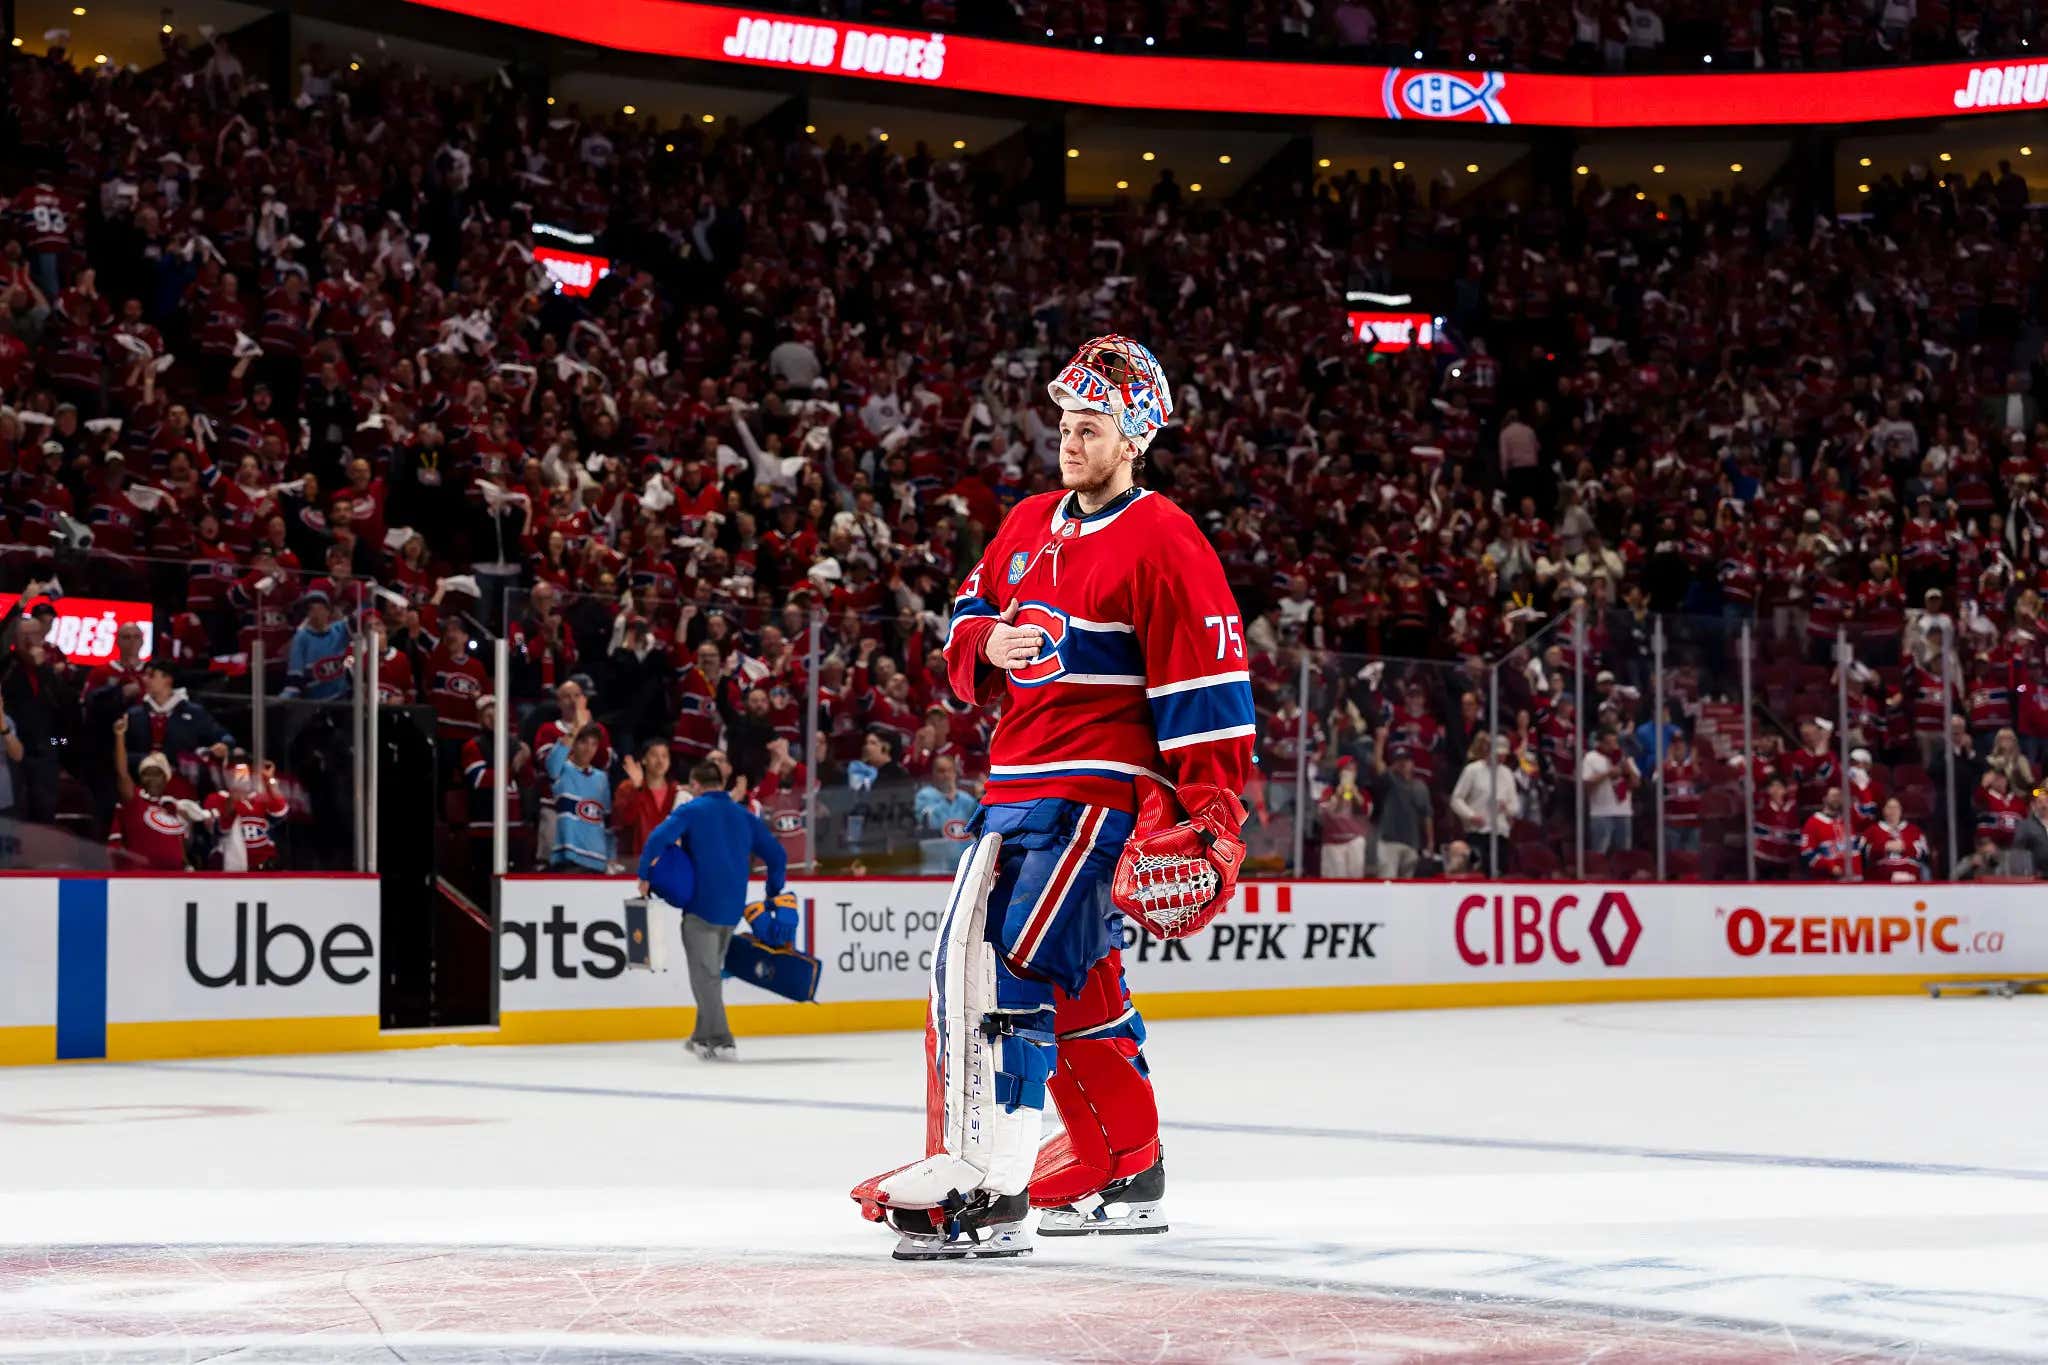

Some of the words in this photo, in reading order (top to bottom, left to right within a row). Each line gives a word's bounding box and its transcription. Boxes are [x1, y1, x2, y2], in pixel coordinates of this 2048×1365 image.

[723, 17, 838, 67] JAKUB
[840, 30, 946, 80] DOBEŠ
[1954, 63, 2048, 108] JAKU
[46, 611, 118, 657] BEŠ
[1204, 615, 1243, 660] 75
[500, 905, 626, 981] ats
[836, 902, 896, 932] Tout
[905, 911, 943, 939] pa
[1208, 924, 1288, 960] PFK
[1303, 923, 1377, 959] PFK
[1455, 894, 1580, 966] CIBC
[186, 902, 373, 988] Ube
[838, 943, 909, 972] d'une
